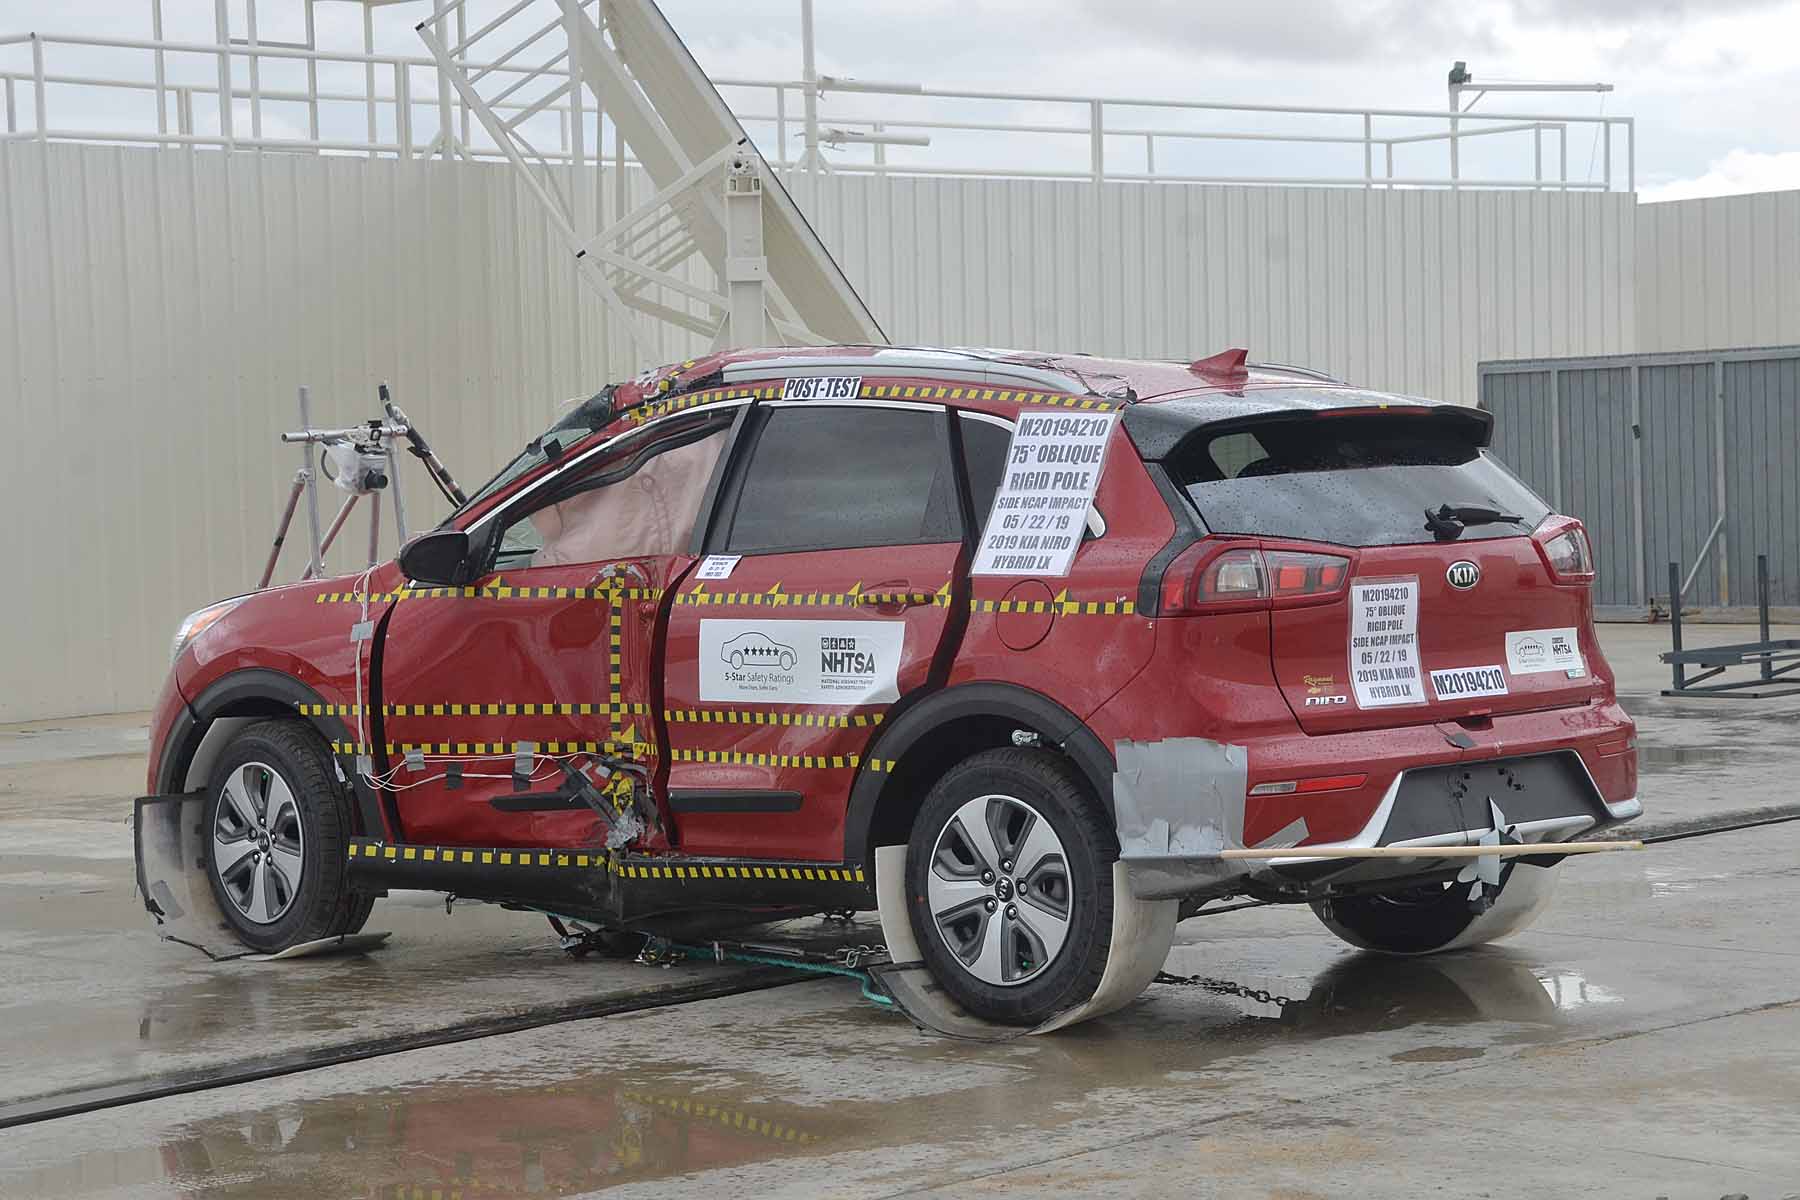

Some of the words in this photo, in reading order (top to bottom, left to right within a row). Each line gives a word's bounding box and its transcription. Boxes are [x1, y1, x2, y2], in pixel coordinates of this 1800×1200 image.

[784, 377, 860, 399] POST-TEST
[1018, 418, 1108, 437] M20194210
[1037, 445, 1102, 465] OBLIQUE
[1009, 471, 1050, 491] RIGID
[1051, 472, 1090, 491] POLE
[997, 497, 1020, 509] SIDE
[1021, 497, 1048, 509] NCAP
[1048, 497, 1089, 510] IMPACT
[988, 535, 1018, 549] 2019
[1018, 536, 1040, 549] KIA
[1041, 536, 1071, 550] NIRO
[991, 555, 1035, 569] HYBRID
[1035, 556, 1053, 569] LX
[1453, 567, 1476, 584] KIA
[1362, 587, 1409, 602] M20194210
[1378, 604, 1406, 617] OBLIQUE
[1367, 621, 1386, 632] RIGID
[1387, 619, 1403, 631] POLE
[1353, 637, 1369, 648] SIDE
[1370, 635, 1389, 647] NCAP
[1389, 633, 1415, 645] IMPACT
[1551, 643, 1573, 656] NHTSA
[821, 652, 876, 674] NHTSA
[725, 672, 746, 681] 5-Star
[747, 672, 768, 683] Safety
[769, 673, 794, 685] Ratings
[1357, 669, 1378, 683] 2019
[1379, 667, 1395, 681] KIA
[1395, 666, 1416, 680] NIRO
[1433, 669, 1506, 695] M20194210
[1369, 685, 1401, 699] HYBRID
[1401, 684, 1413, 697] LX
[999, 879, 1009, 899] KIA
